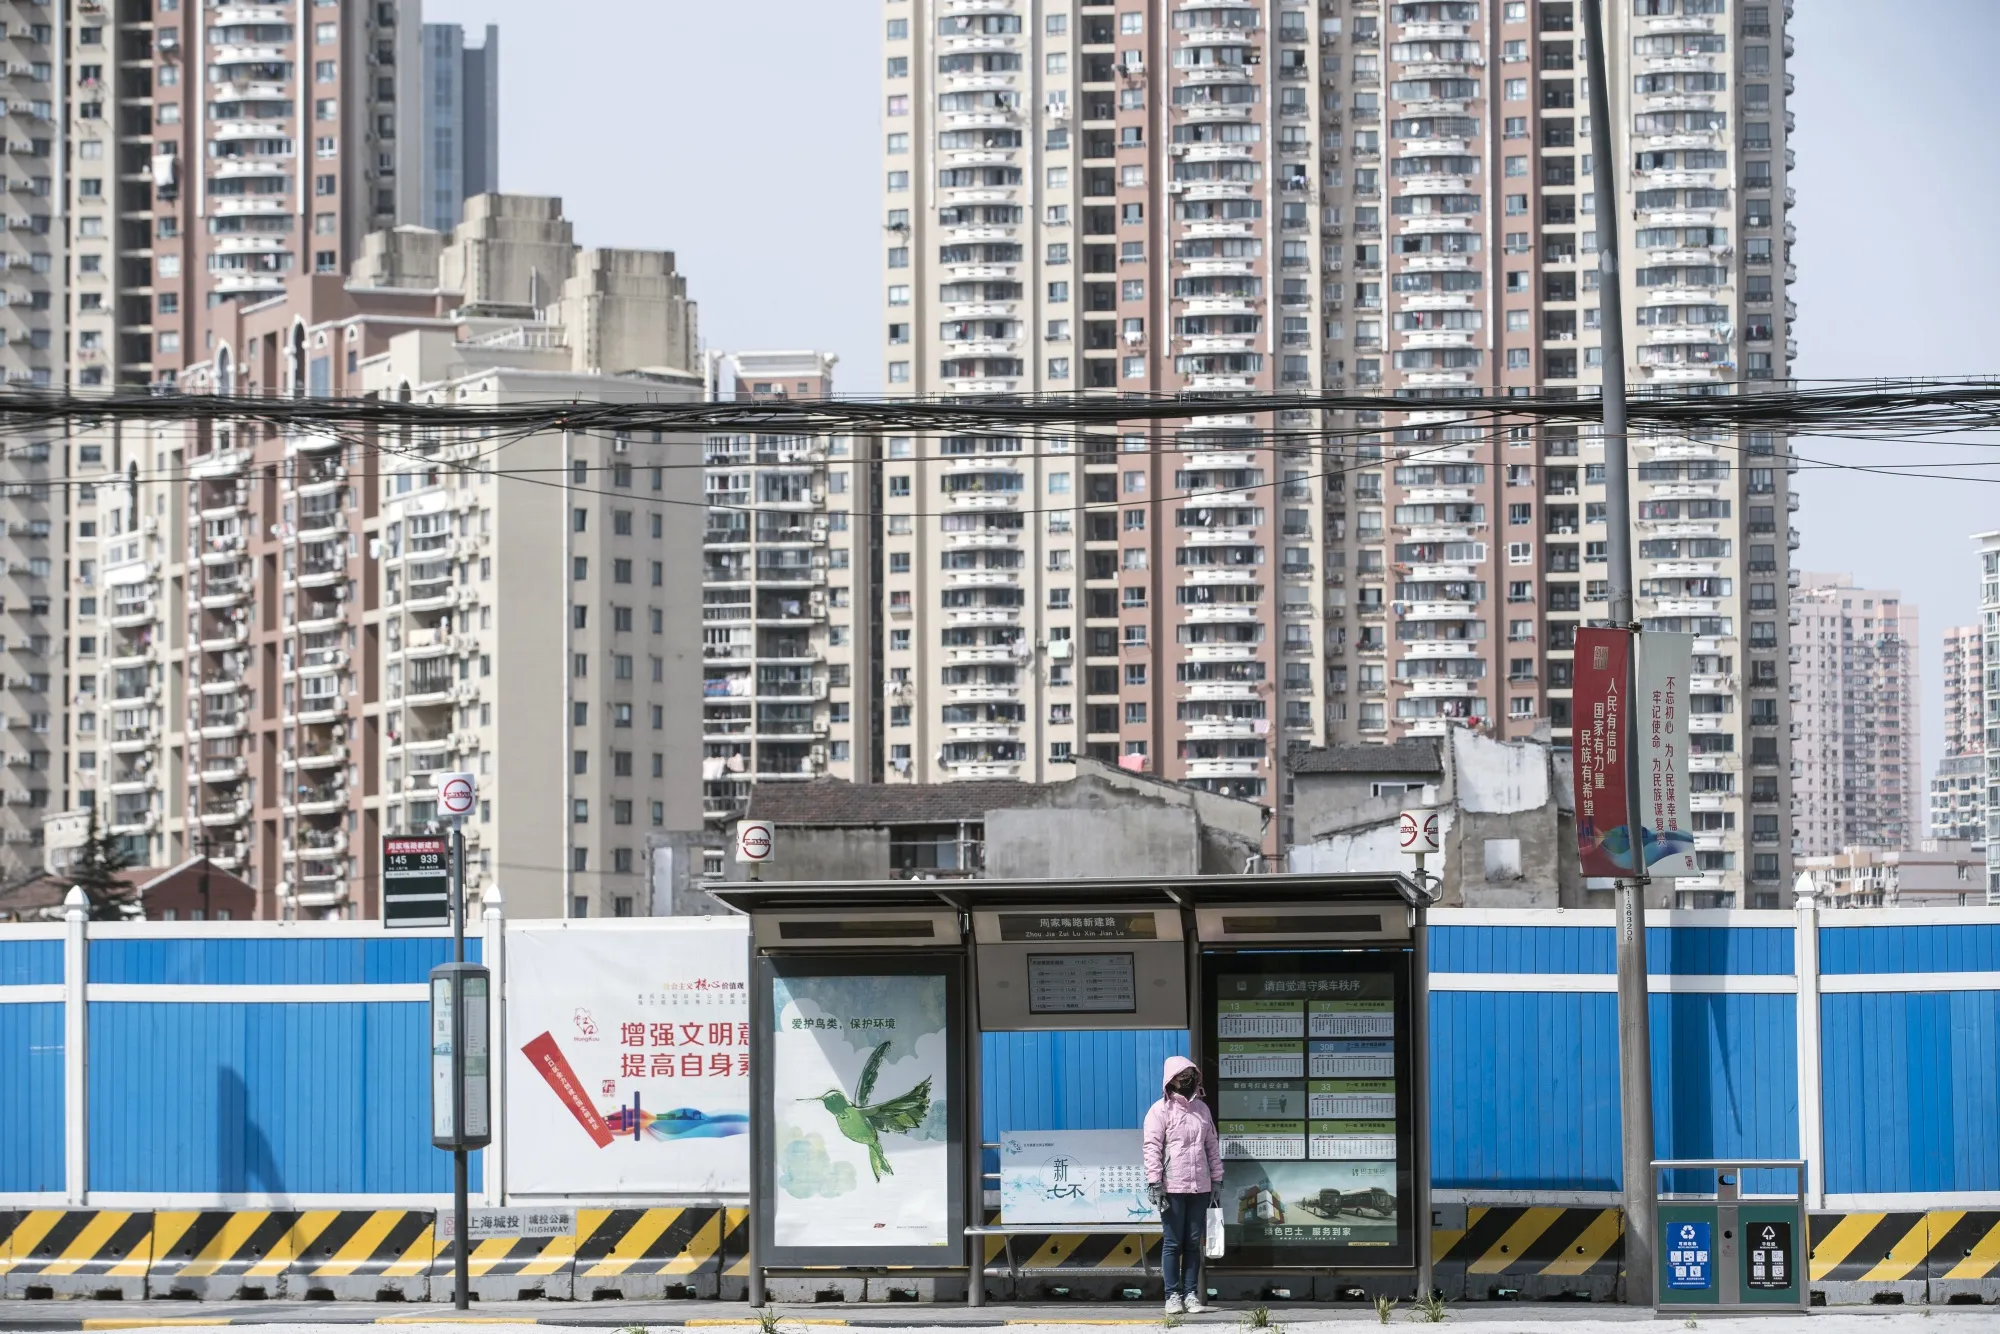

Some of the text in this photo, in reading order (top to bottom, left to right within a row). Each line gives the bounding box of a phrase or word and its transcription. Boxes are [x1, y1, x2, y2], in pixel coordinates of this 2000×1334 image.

[1606, 677, 1618, 765] 人民有信仰
[1593, 702, 1606, 790] 国家有力量
[1664, 676, 1678, 832] 不忘初心 为人民谋幸福
[1581, 729, 1595, 817] 民族有希望
[1651, 690, 1667, 846] 牢记使命 为民族谋复兴
[390, 855, 407, 865] 145
[420, 854, 438, 863] 939
[1040, 917, 1116, 928] 周家嘴路新建路
[1264, 979, 1361, 992] 请自觉遵守乘车秩序
[1230, 1003, 1240, 1011] 13
[1321, 1003, 1331, 1011] 17
[791, 1018, 896, 1030] 爱护鸟类，保护环境
[1229, 1044, 1244, 1052] 220
[1229, 1124, 1244, 1132] 510
[1047, 1158, 1085, 1198] 新 七不
[468, 1215, 520, 1229] 上海城投
[528, 1214, 570, 1225] 城投公路
[528, 1226, 569, 1234] HIGHWAY
[1264, 1227, 1352, 1236] 绿色巴士 服务到家
